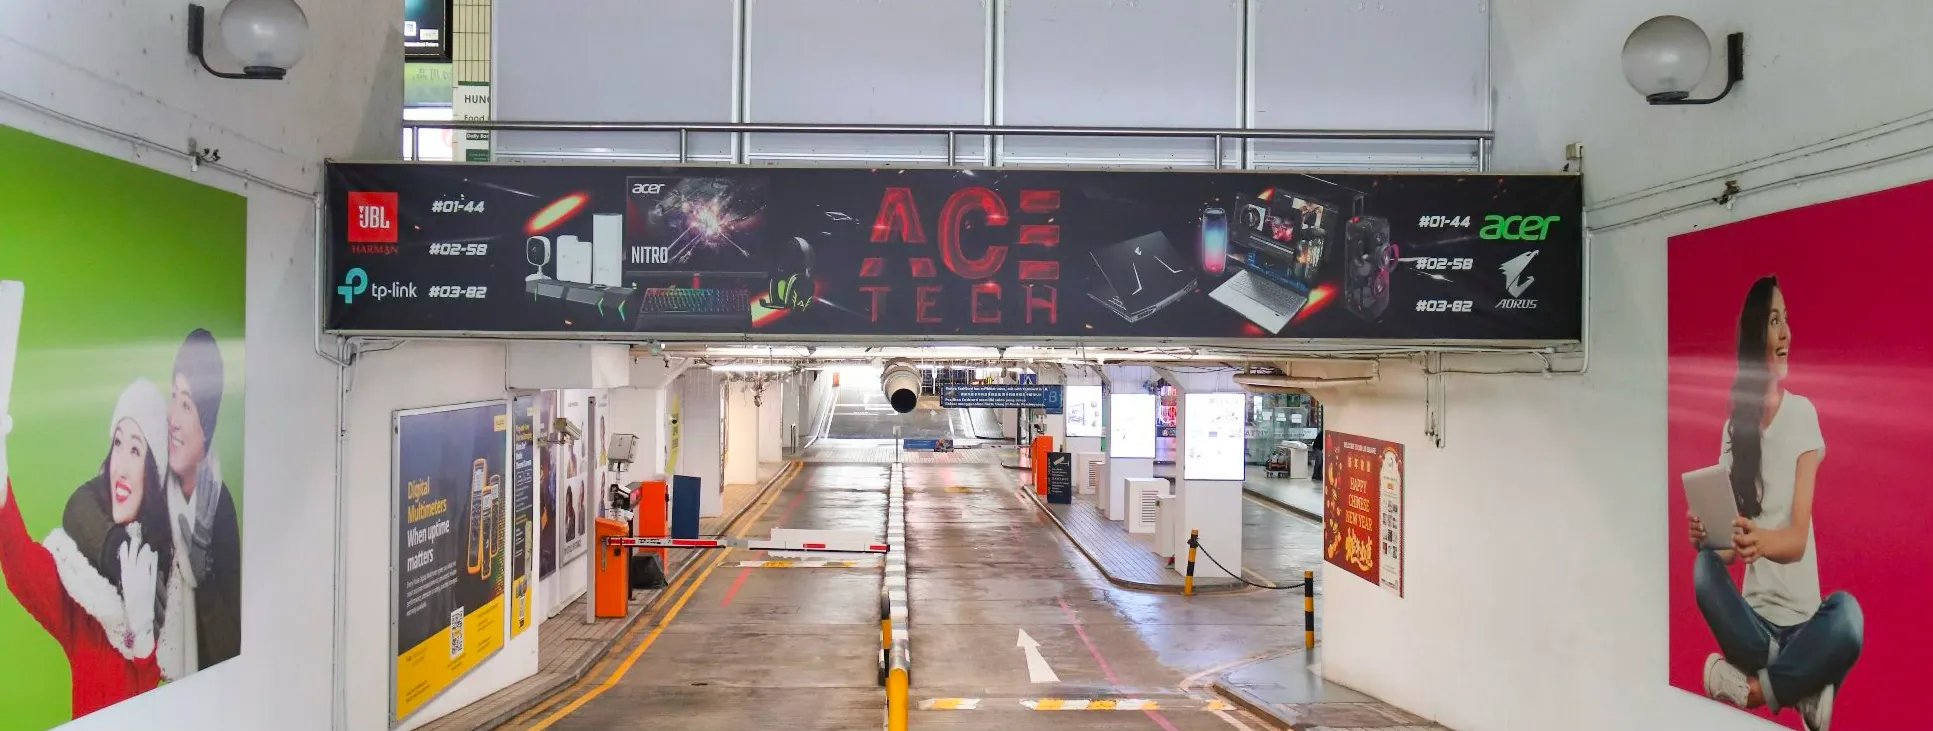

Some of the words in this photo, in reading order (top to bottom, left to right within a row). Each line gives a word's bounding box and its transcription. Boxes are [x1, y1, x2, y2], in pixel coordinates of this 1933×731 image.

[631, 182, 665, 194] acer
[431, 200, 485, 213] #01-44
[359, 205, 390, 229] JBL
[1418, 215, 1471, 228] #01-44
[859, 186, 1061, 280] ACE
[1479, 214, 1560, 241] acer
[352, 244, 398, 255] HARMAN
[429, 243, 488, 256] #02-58
[631, 246, 668, 264] NITRO
[1416, 258, 1473, 270] #02-58
[371, 281, 418, 301] tp-link
[428, 286, 487, 299] #03-82
[859, 284, 1058, 324] TECH
[1416, 300, 1473, 313] #03-82
[1495, 299, 1539, 310] AORUS
[407, 476, 430, 502] Digital
[1350, 477, 1367, 494] HAPPY
[407, 498, 447, 523] Multimeters
[1348, 494, 1370, 512] CHINESE
[1345, 509, 1358, 526] NEW
[1357, 514, 1373, 532] YEAR
[407, 525, 427, 548] When
[427, 519, 450, 544] uptime
[406, 548, 434, 573] matters
